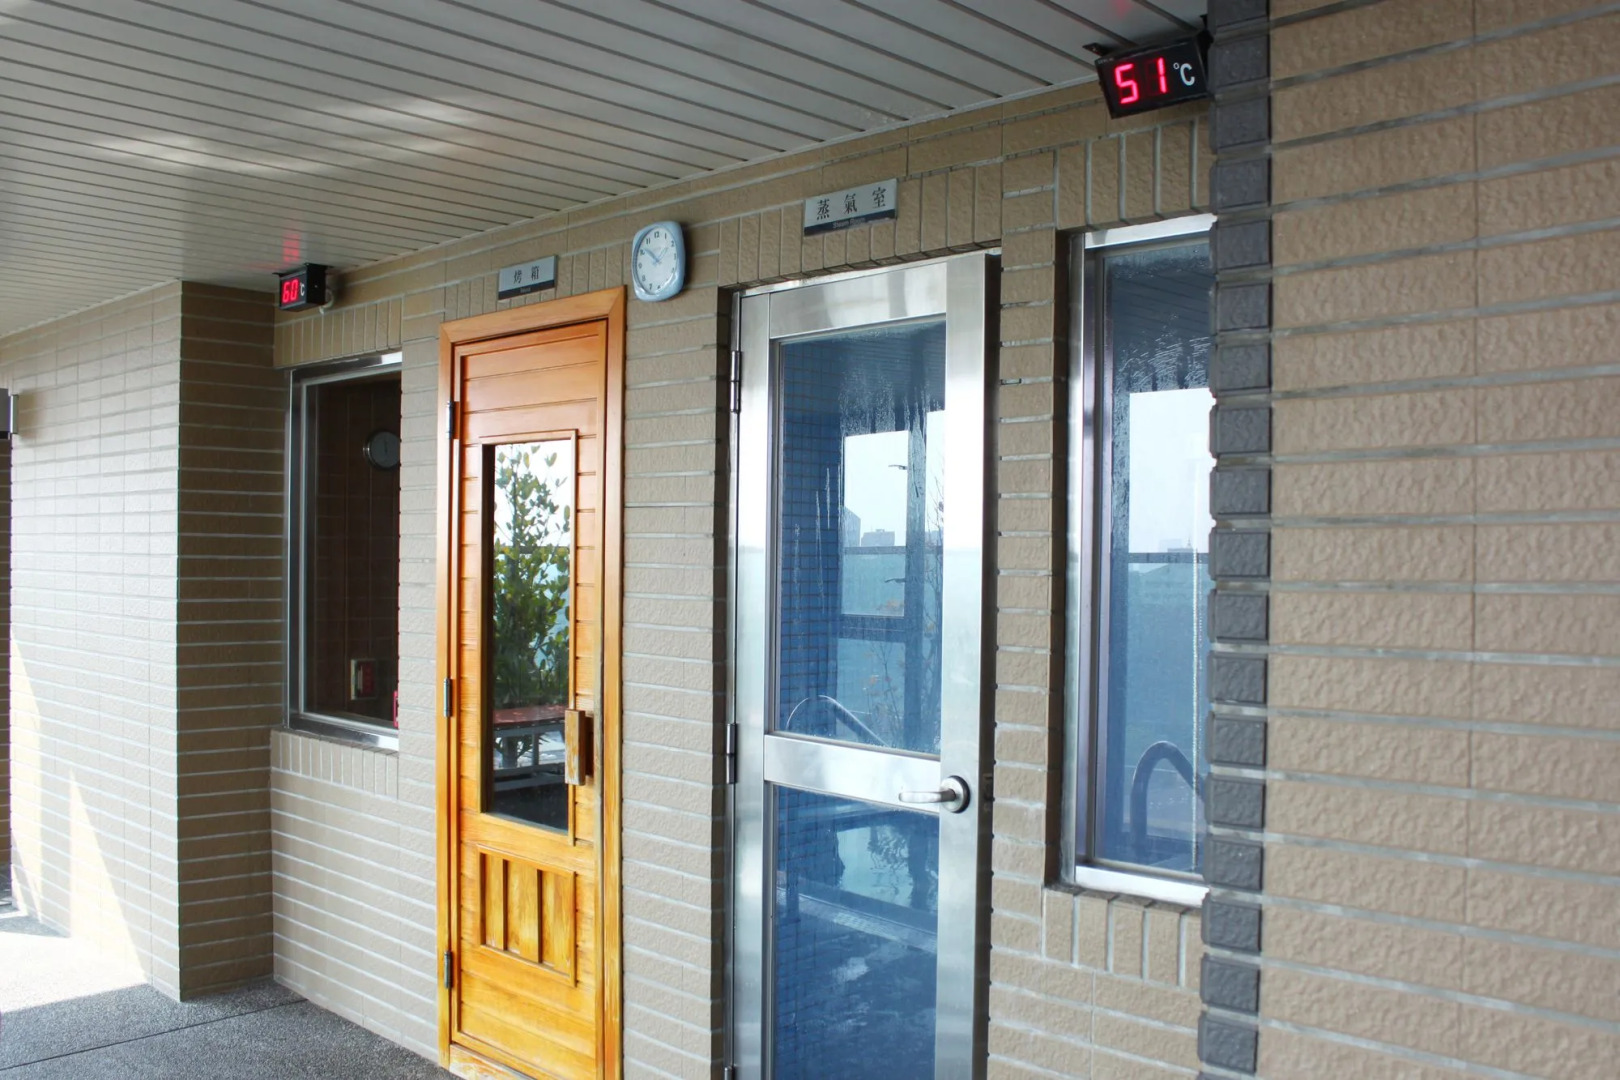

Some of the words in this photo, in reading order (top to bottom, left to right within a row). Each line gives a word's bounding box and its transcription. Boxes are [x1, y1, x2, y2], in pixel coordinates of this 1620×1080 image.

[1114, 57, 1168, 105] 51
[816, 186, 887, 221] 蒸氣室
[282, 278, 300, 304] 60
